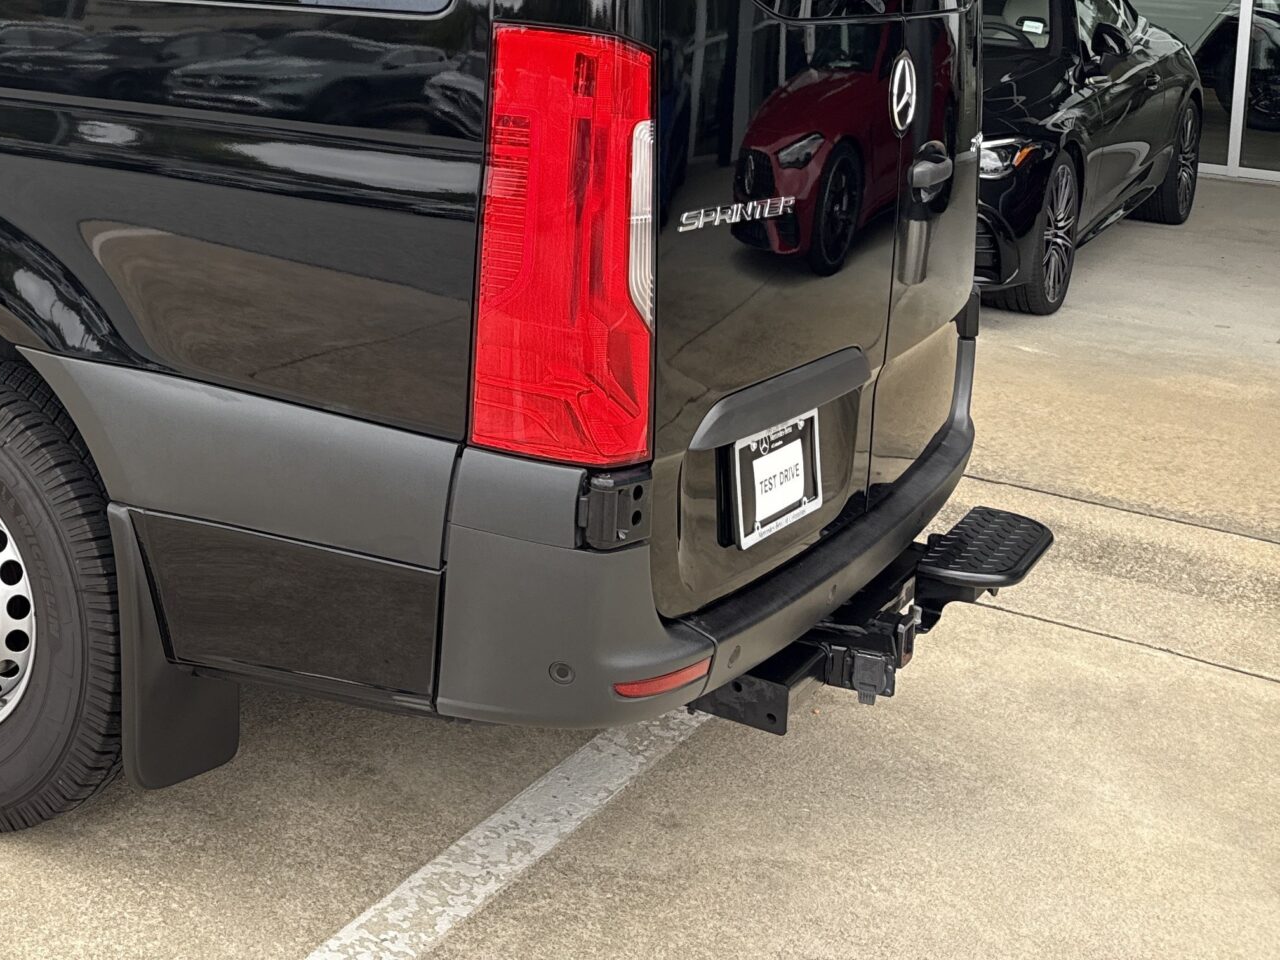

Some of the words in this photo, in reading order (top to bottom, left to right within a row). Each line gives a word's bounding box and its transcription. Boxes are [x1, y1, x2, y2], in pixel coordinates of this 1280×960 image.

[677, 196, 795, 233] SPRINTER
[759, 473, 777, 496] TEST
[779, 462, 800, 486] DRIVE
